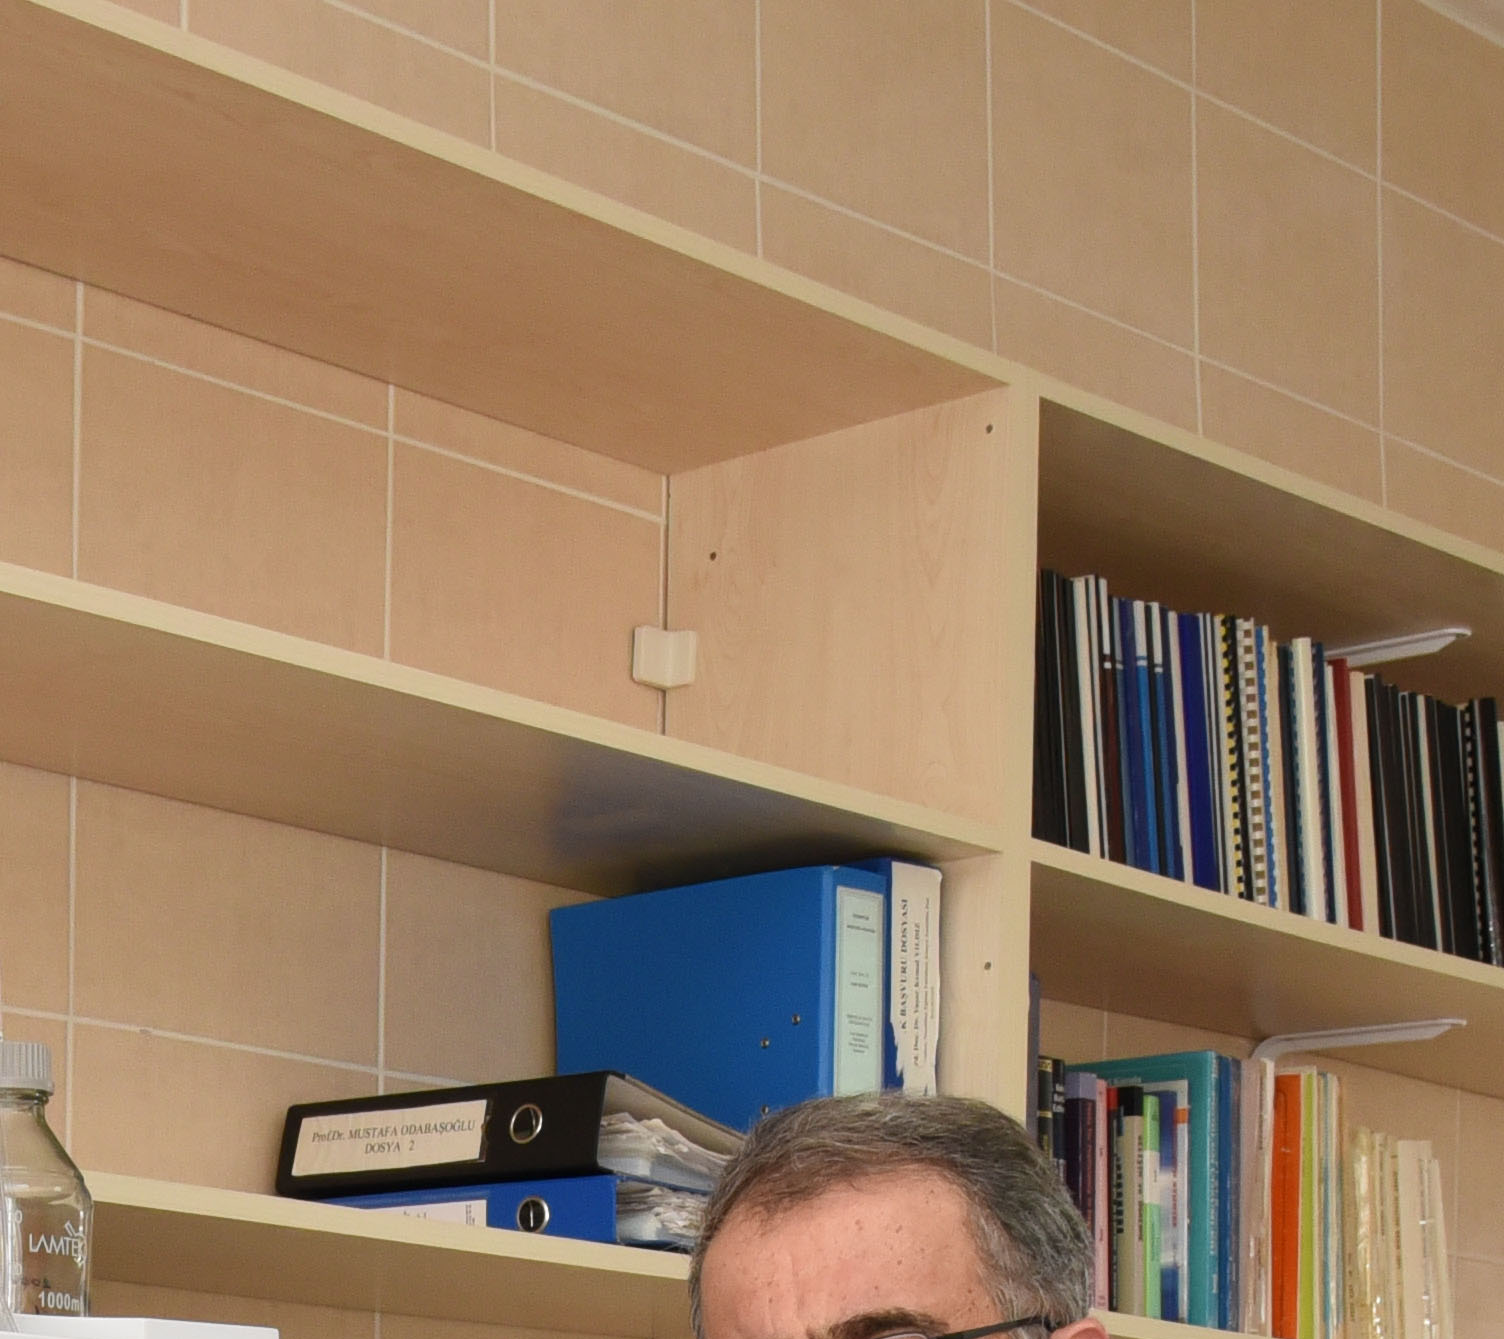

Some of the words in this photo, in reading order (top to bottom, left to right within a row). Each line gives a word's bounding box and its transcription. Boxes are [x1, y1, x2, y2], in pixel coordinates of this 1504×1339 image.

[900, 899, 909, 953] DOSYASI
[347, 1126, 399, 1140] MUSTAFA
[400, 1119, 476, 1138] ODABAŞOĞLU
[365, 1141, 401, 1154] DOSYA
[408, 1140, 415, 1151] 2
